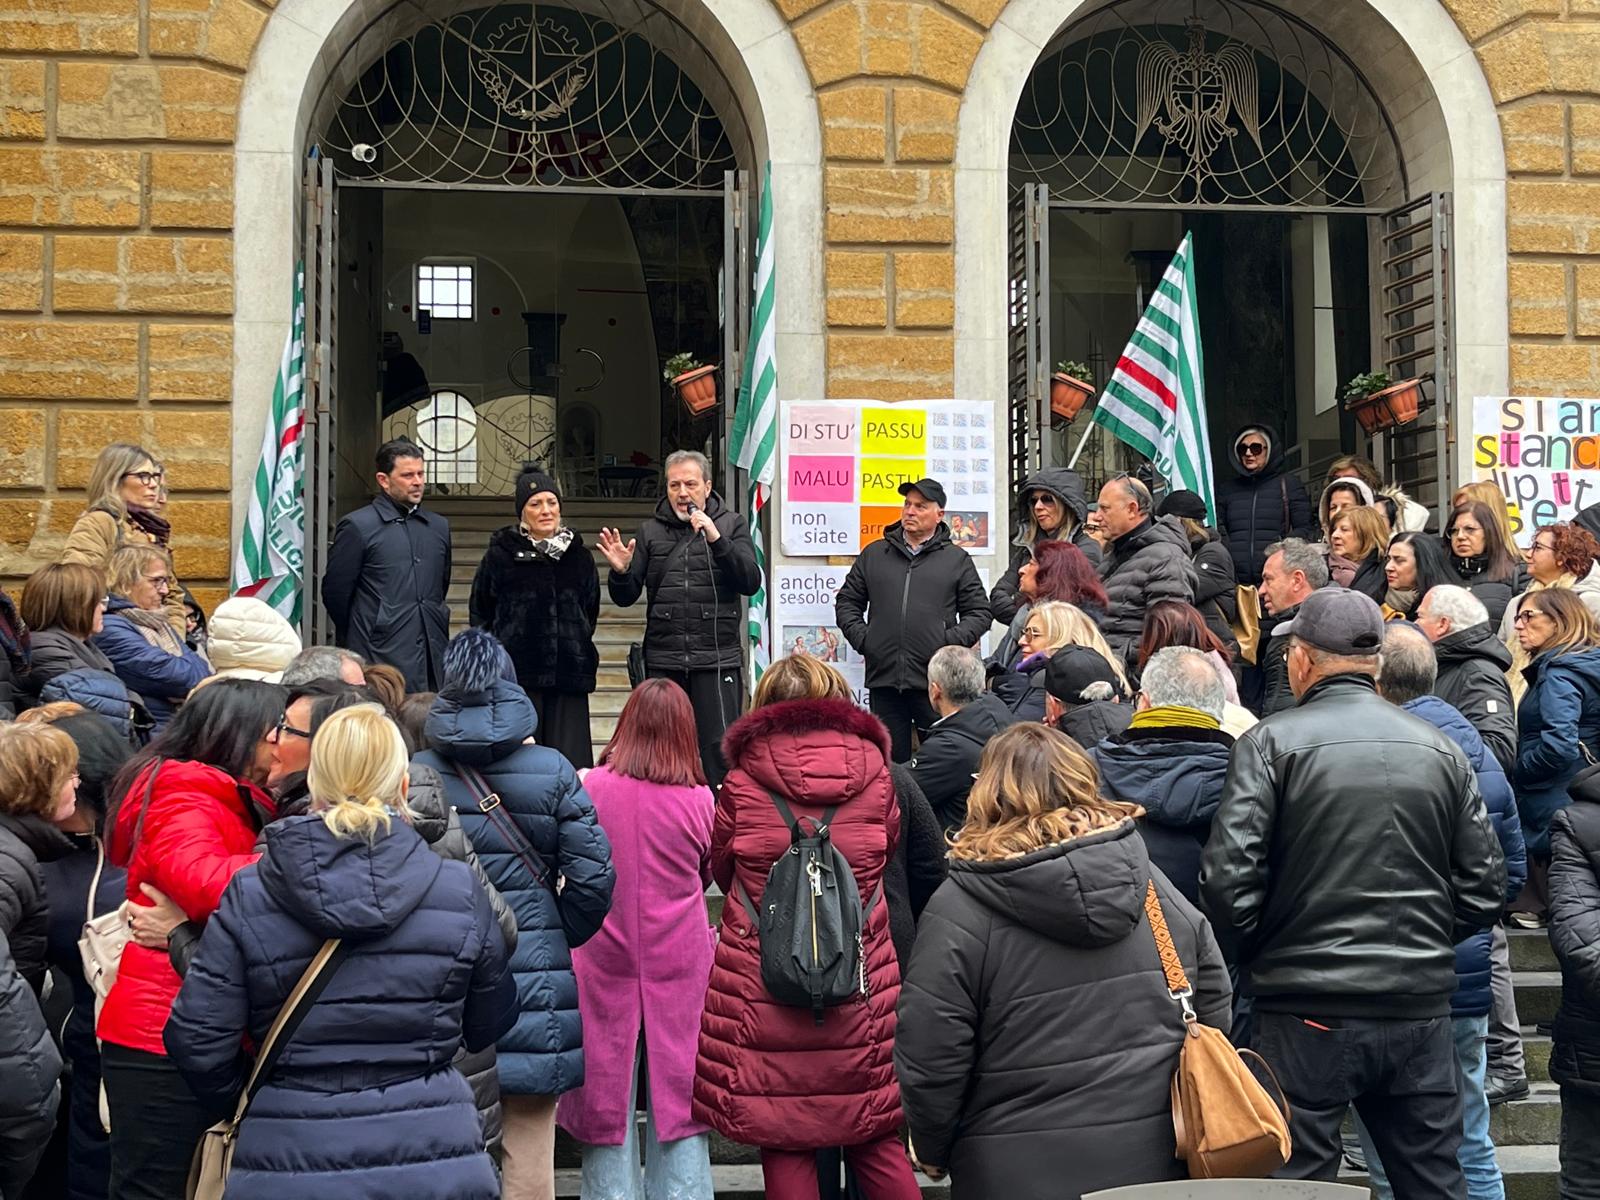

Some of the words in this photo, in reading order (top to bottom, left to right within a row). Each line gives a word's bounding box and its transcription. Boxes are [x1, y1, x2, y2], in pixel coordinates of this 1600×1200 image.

[507, 131, 609, 178] BAR
[790, 423, 808, 439] DI
[866, 422, 924, 439] PASSU
[1475, 434, 1600, 470] stanc
[794, 470, 849, 487] MALU
[792, 512, 827, 526] non
[804, 528, 848, 544] siate
[781, 572, 837, 590] anche
